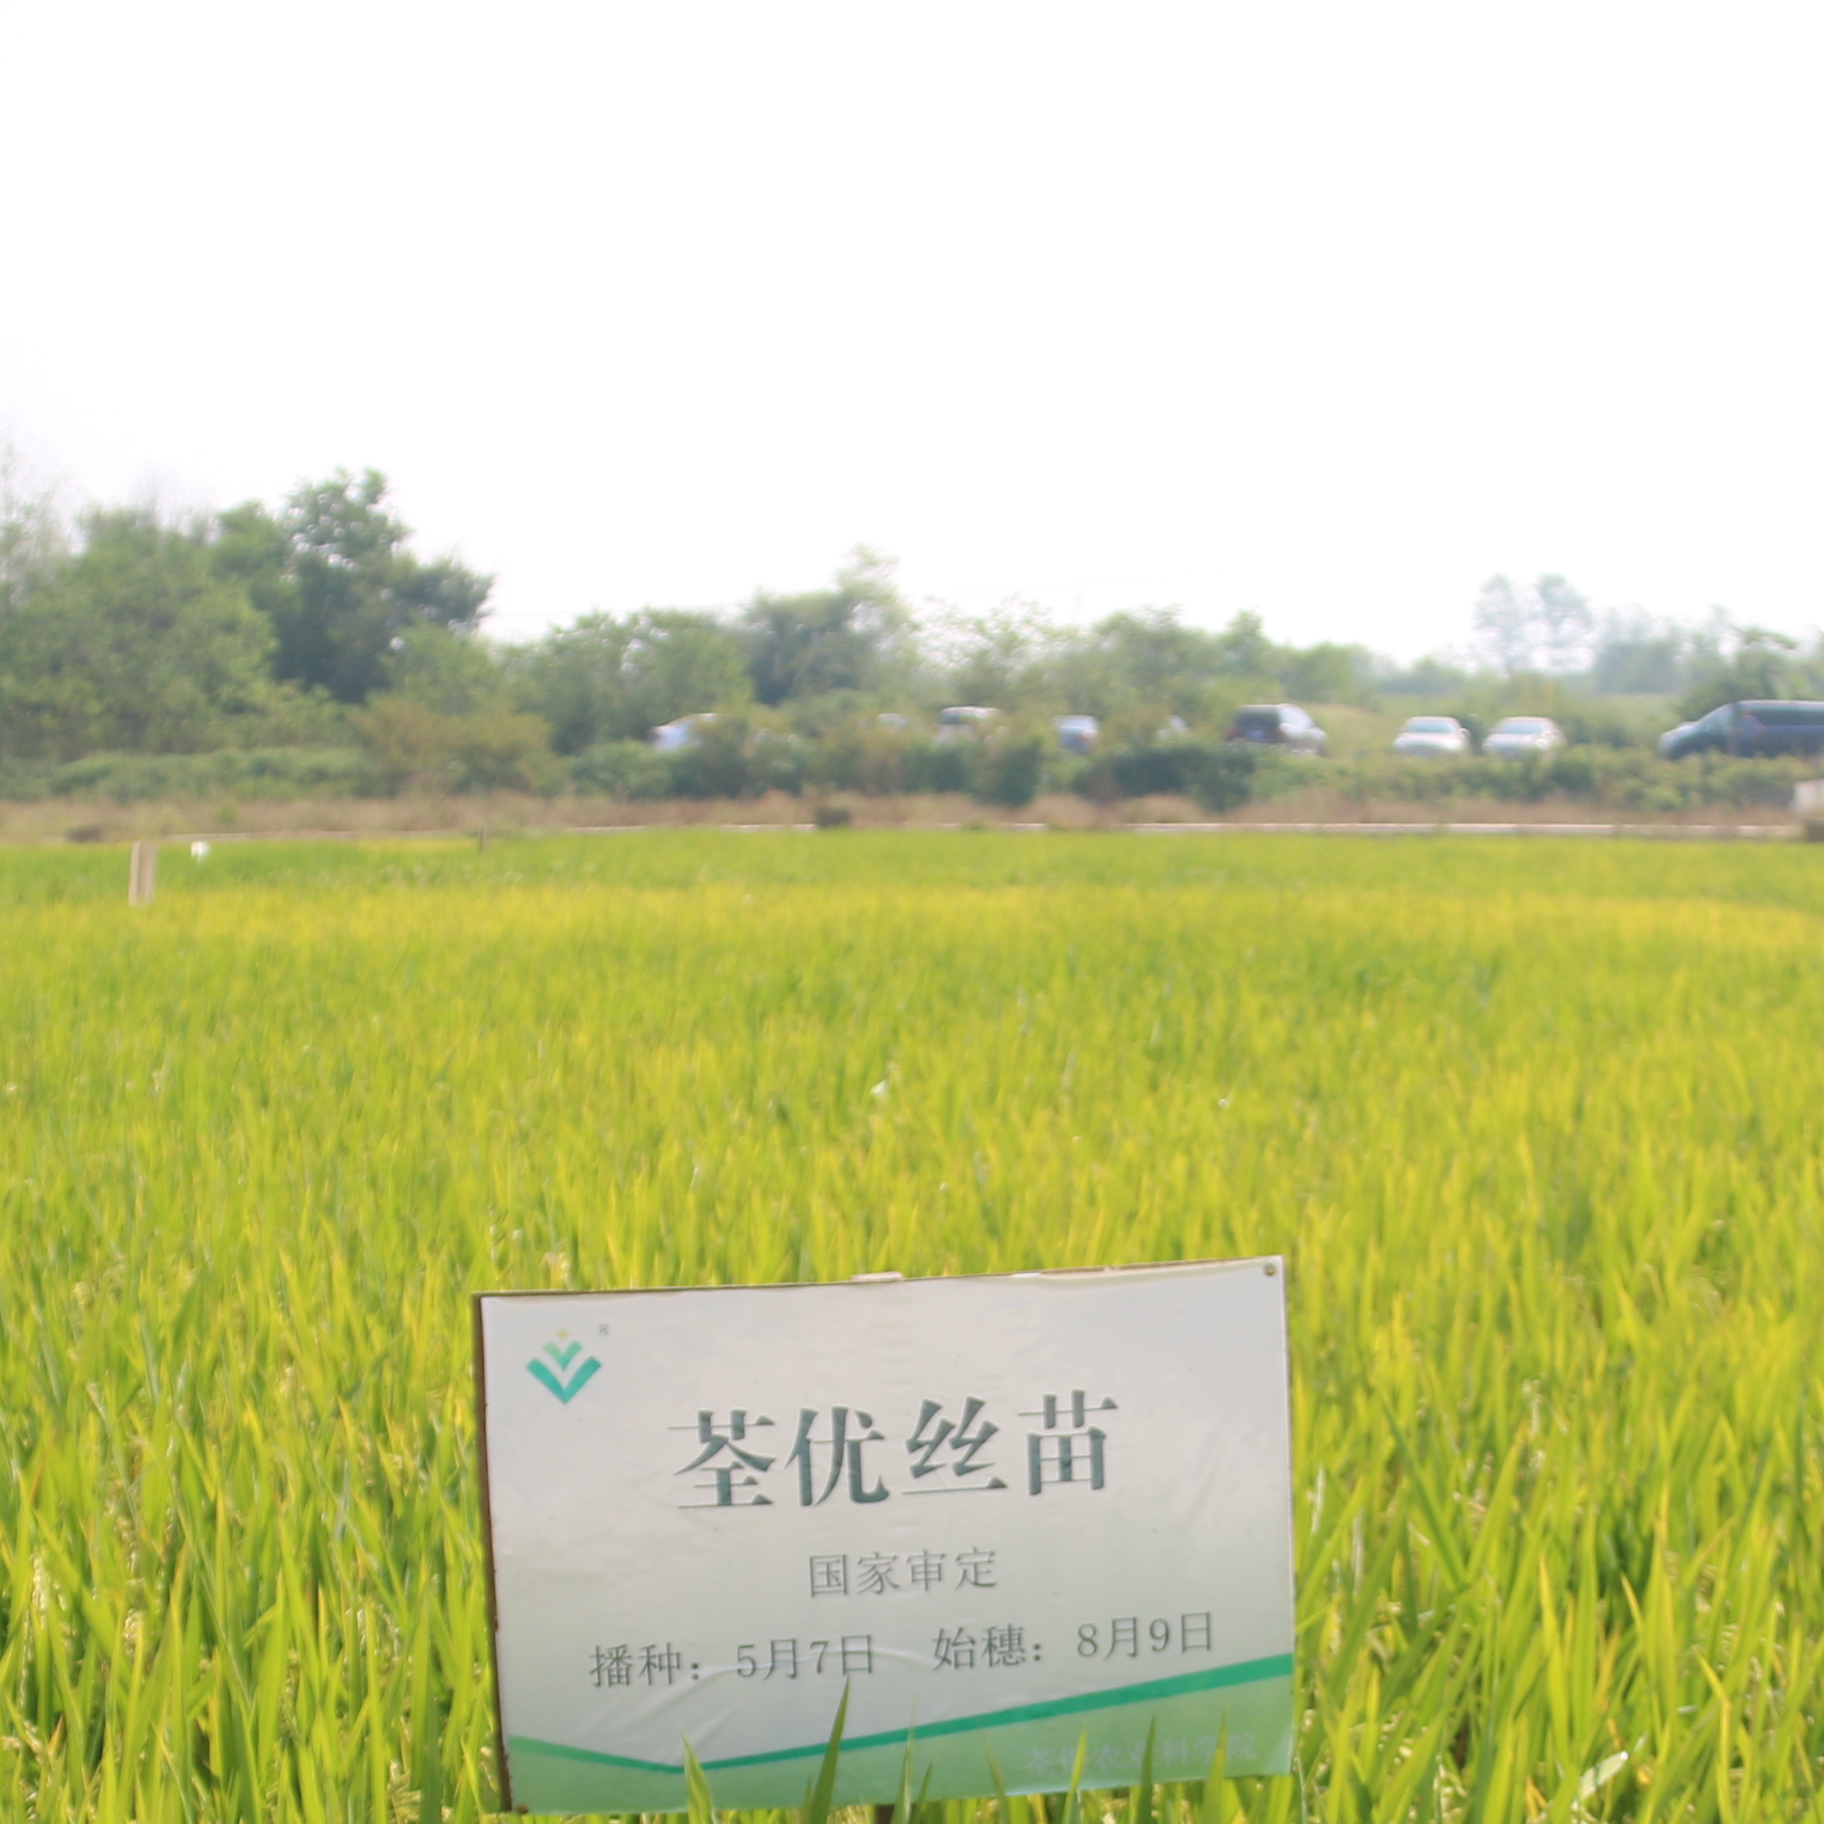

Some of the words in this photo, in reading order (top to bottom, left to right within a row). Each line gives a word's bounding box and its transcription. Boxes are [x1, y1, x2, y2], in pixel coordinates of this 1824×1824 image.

[669, 1389, 1118, 1509] 荃优丝苗
[809, 1546, 998, 1598] 国家审定
